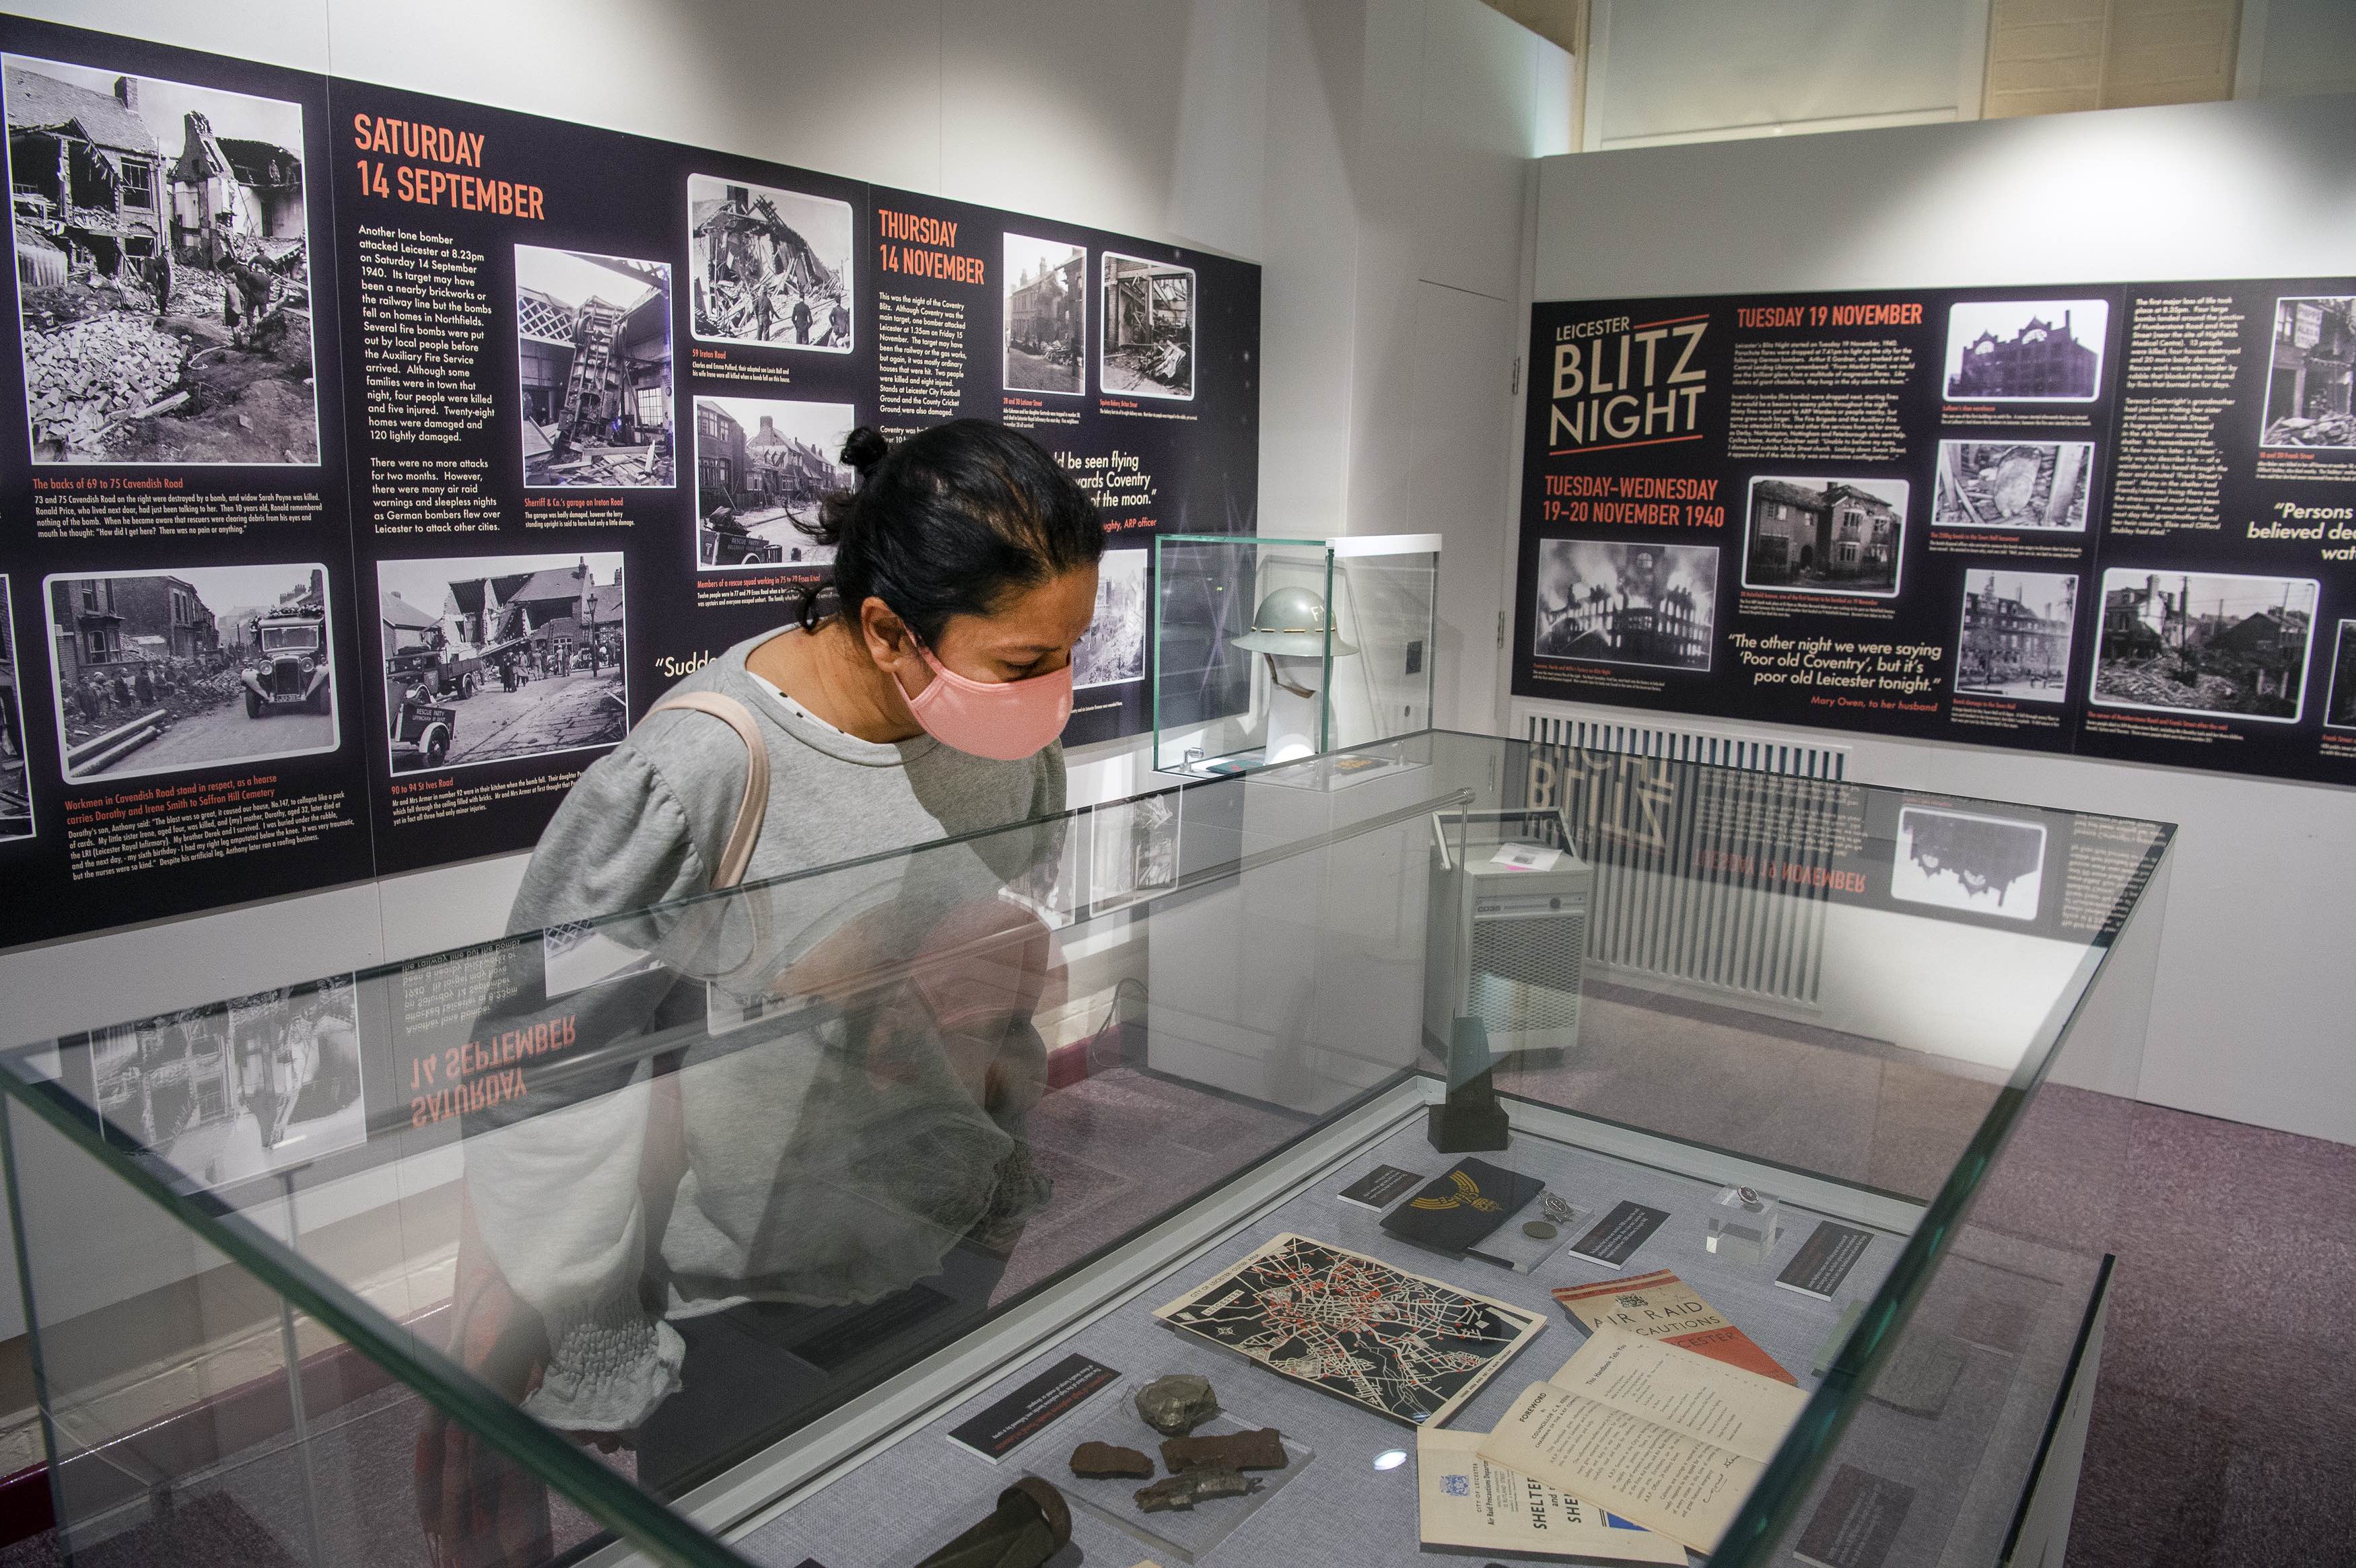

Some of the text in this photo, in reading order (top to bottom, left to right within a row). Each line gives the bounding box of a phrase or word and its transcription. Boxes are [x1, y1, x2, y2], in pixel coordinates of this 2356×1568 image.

[354, 113, 485, 168] SATURDAY
[357, 160, 545, 220] 14 SEPTEMBER
[359, 225, 453, 244] Another lone bomber
[878, 209, 958, 248] THURSDAY
[359, 240, 398, 251] attacked
[401, 243, 438, 256] Leicester
[452, 249, 484, 262] 8.23pm
[375, 254, 415, 269] Saturday
[419, 258, 429, 268] 14
[432, 260, 477, 273] September
[880, 244, 985, 285] 14 NOVEMBER
[362, 266, 475, 286] 1940. Its target may have
[361, 279, 384, 291] been
[396, 285, 426, 297] nearby
[429, 285, 475, 299] brickworks
[362, 293, 491, 314] the railway line but the bombs
[363, 307, 376, 317] fell
[394, 310, 421, 321] homes
[425, 313, 432, 322] in
[436, 314, 483, 326] Northfields.
[1738, 304, 1922, 326] TUESDAY 19 NOVEMBER
[364, 322, 396, 332] Several
[400, 323, 414, 334] fire
[417, 325, 445, 336] bombs
[471, 332, 484, 341] put
[1556, 316, 1630, 341] LEICESTER
[382, 336, 392, 348] by
[396, 336, 416, 347] local
[419, 340, 448, 351] people
[452, 341, 479, 351] before
[365, 349, 473, 364] the Auxiliary Fire Service
[1552, 322, 1709, 400] BLITZ
[366, 363, 401, 373] arrived.
[407, 365, 445, 378] Although
[367, 376, 400, 386] families
[427, 380, 434, 388] in
[437, 381, 457, 389] town
[460, 380, 475, 390] that
[368, 390, 391, 402] night,
[395, 390, 413, 400] four
[416, 392, 445, 404] people
[471, 394, 491, 403] killed
[368, 403, 494, 419] and five injured. Twenty-eight
[1550, 385, 1706, 446] NIGHT
[369, 417, 397, 426] homes
[424, 418, 464, 430] damaged
[466, 420, 482, 429] and
[371, 430, 461, 443] 120 lightly damaged.
[1068, 452, 1082, 469] be
[1084, 457, 1108, 468] seen
[1111, 450, 1139, 472] flying
[33, 478, 183, 489] The backs of 69 to 75 Cavendish Road
[1107, 471, 1150, 490] Coventry
[1103, 490, 1119, 507] the
[1593, 501, 1680, 526] NOVEMBER
[1686, 505, 1725, 528] 1940
[1103, 517, 1157, 532] ughty, ARP officer
[2246, 522, 2325, 539] believed
[2321, 546, 2356, 560] wat
[1760, 635, 1795, 650] other
[1797, 637, 1832, 655] night
[1835, 643, 1855, 652] we
[1858, 644, 1892, 654] were
[1896, 643, 1942, 660] saying
[1777, 652, 1800, 666] old
[1877, 656, 1901, 672] but
[1754, 673, 1787, 685] poor
[1791, 670, 1813, 684] old
[1817, 672, 1875, 688] Leicester
[1811, 697, 1835, 707] Mary
[1881, 700, 1896, 709] her
[1898, 701, 1938, 711] husband
[1593, 1302, 1702, 1328] AIR RAID
[1636, 1316, 1721, 1337] CAUTIONS
[1675, 1331, 1736, 1349] CESTER
[1519, 1392, 1547, 1423] FOREWORD
[1484, 1478, 1493, 1505] Precautions
[1486, 1505, 1494, 1516] Raid
[1564, 1493, 1581, 1523] SHE
